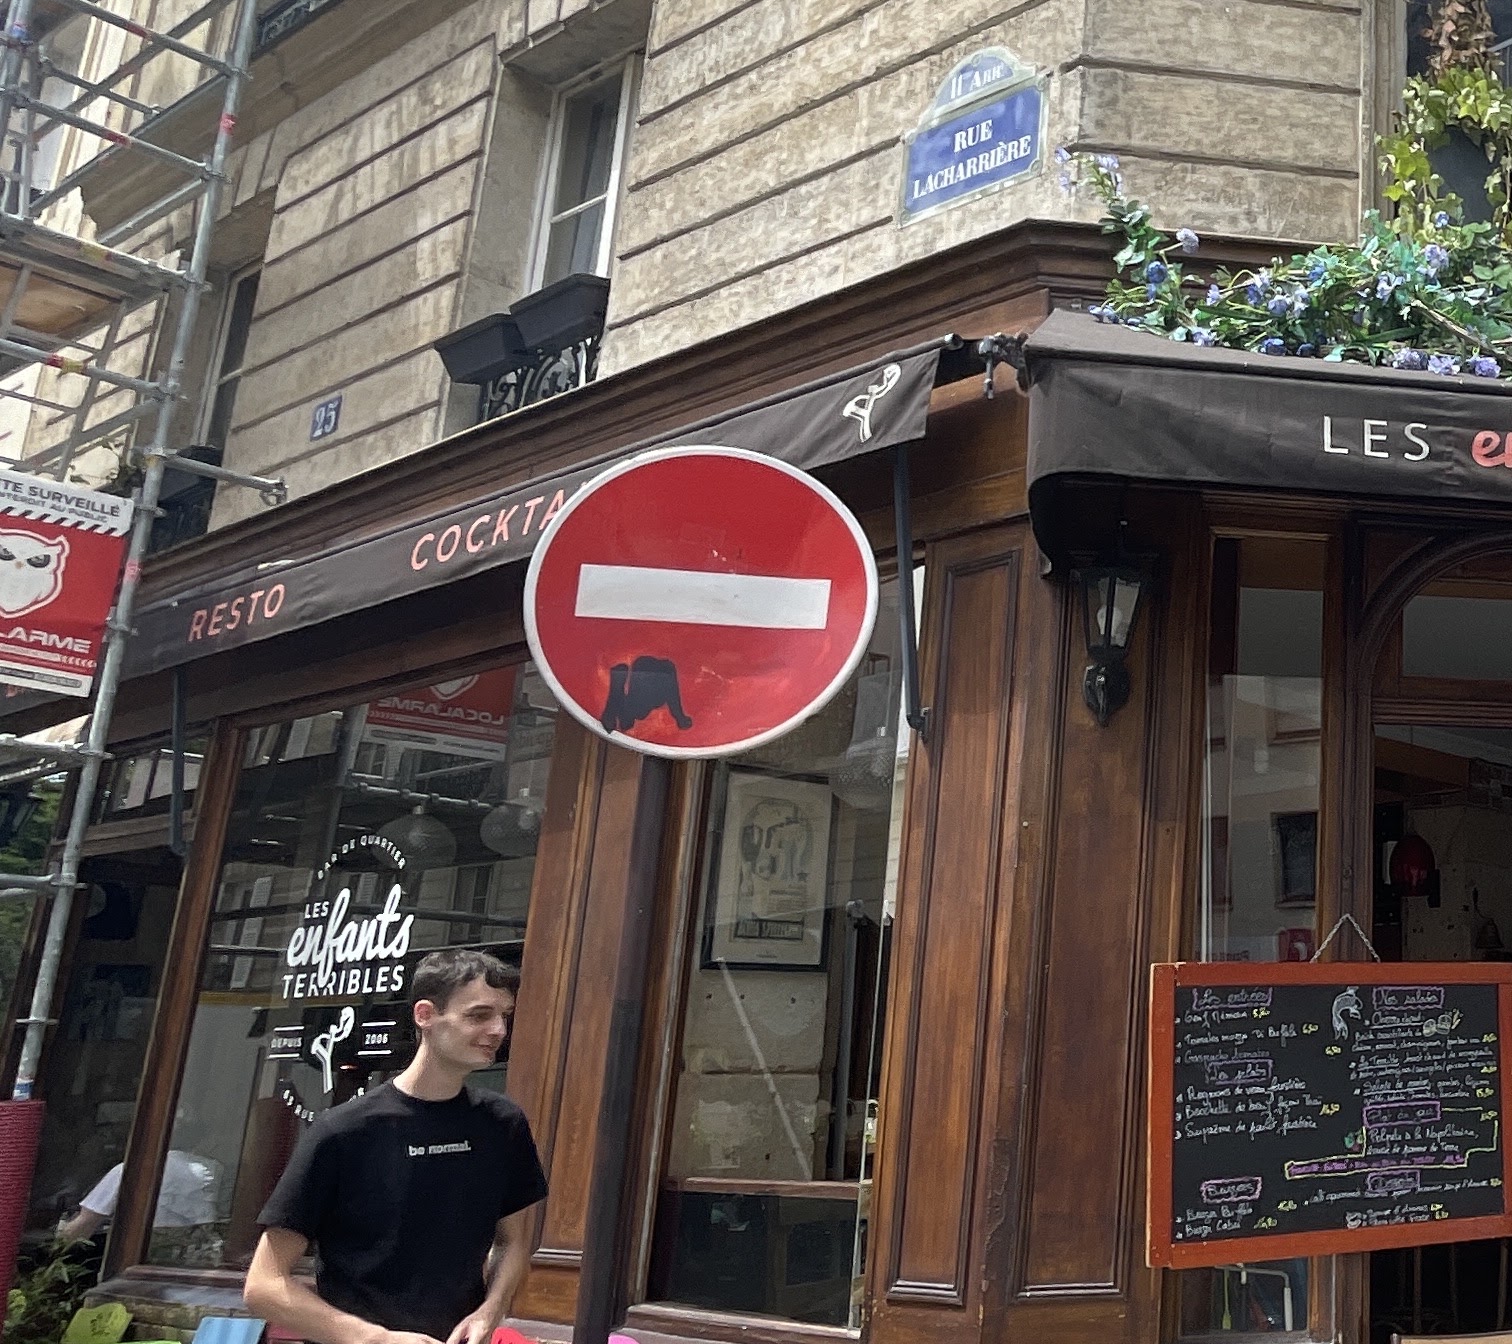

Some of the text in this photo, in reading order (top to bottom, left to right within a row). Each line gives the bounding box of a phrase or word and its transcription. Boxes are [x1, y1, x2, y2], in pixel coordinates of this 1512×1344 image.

[954, 119, 993, 153] RUE
[912, 134, 1032, 200] LACHARRIÈRE
[313, 400, 340, 437] 25
[1322, 415, 1432, 462] LES
[187, 488, 567, 643] RESTO COCKTA
[360, 834, 407, 870] QUARTIER
[286, 882, 415, 968] enfants
[304, 900, 330, 919] LES
[281, 964, 405, 1000] TERRIBLES
[270, 1033, 389, 1049] DEPUIS 2006
